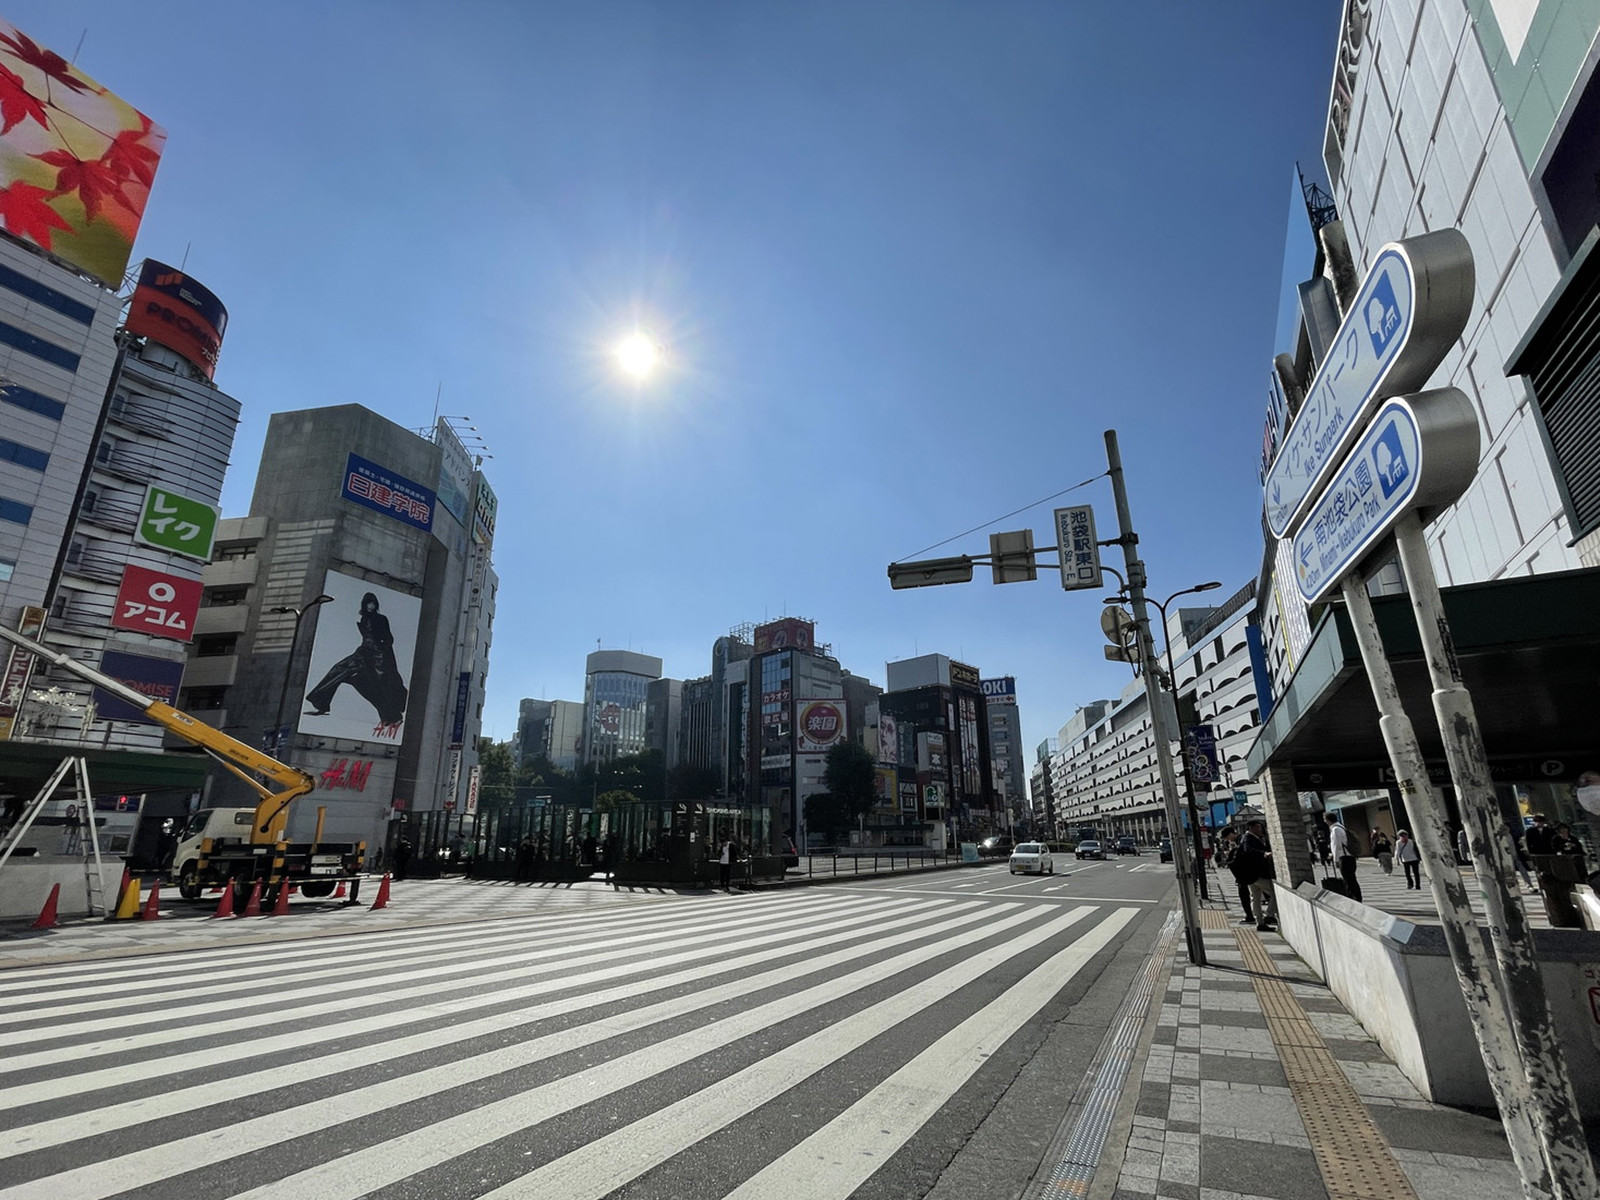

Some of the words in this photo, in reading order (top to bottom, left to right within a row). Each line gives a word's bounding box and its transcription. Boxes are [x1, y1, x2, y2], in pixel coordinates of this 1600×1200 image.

[1303, 455, 1316, 478] Ike
[1315, 406, 1345, 460] Sunpark
[1313, 458, 1373, 551] 南池袋公園
[1362, 492, 1381, 522] Park
[1060, 513, 1070, 548] Ikebukuro
[1070, 511, 1093, 580] 池袋駅東口
[124, 601, 186, 630] アコム
[763, 691, 789, 703] カラオケ
[807, 715, 837, 731] 楽園
[319, 758, 373, 792] H&M
